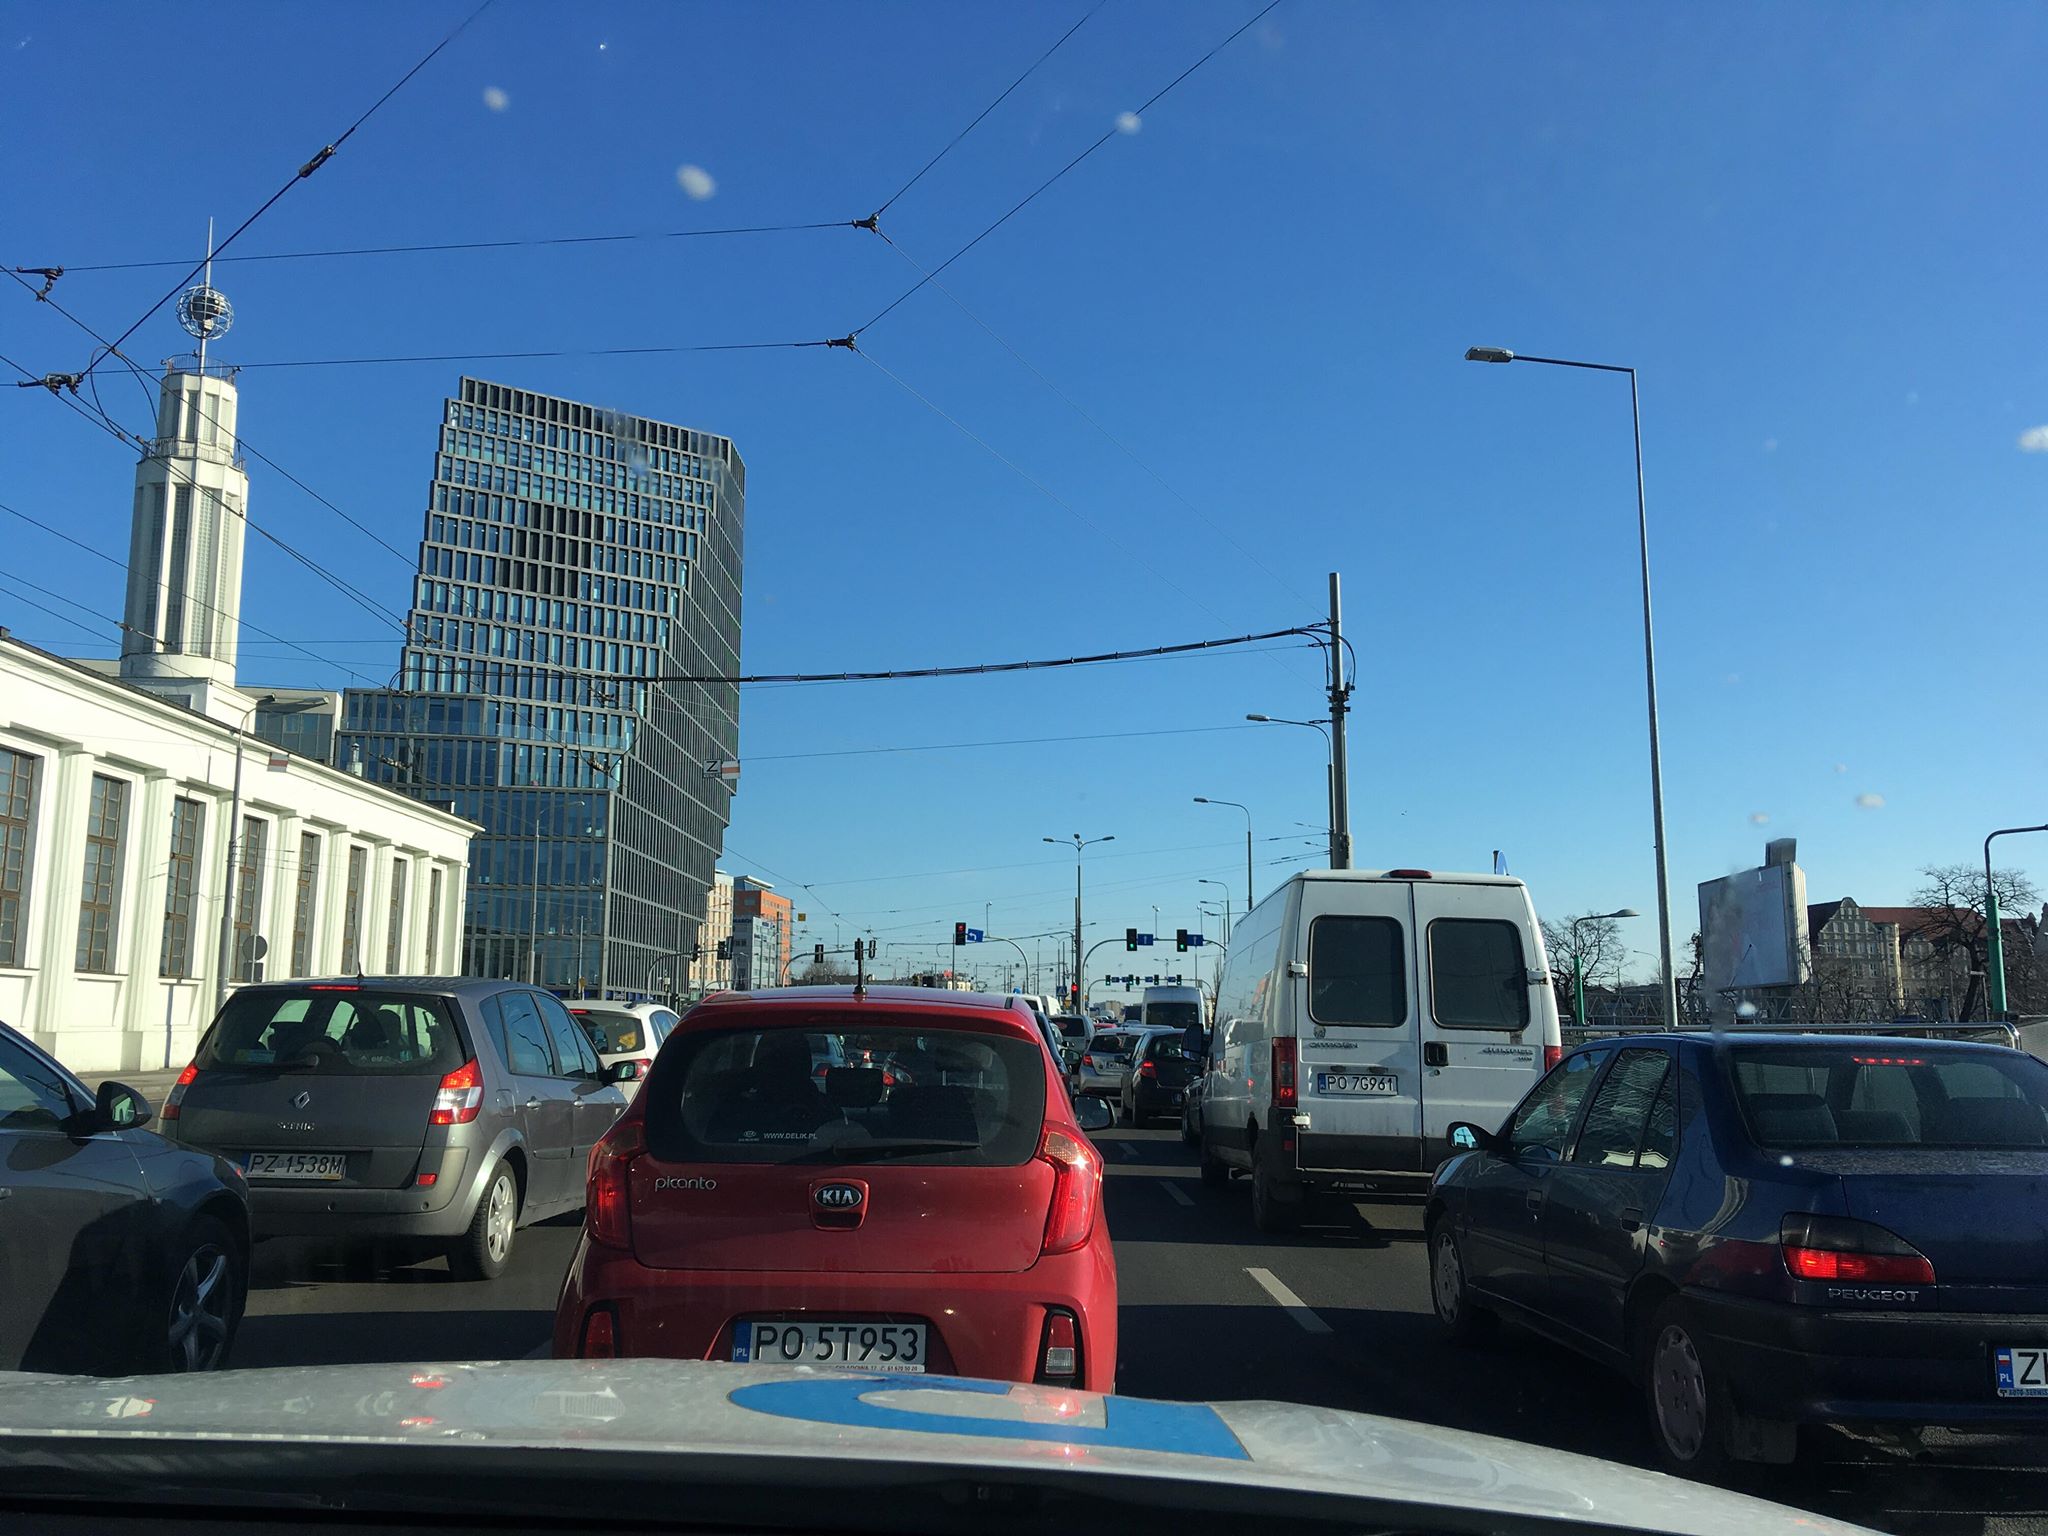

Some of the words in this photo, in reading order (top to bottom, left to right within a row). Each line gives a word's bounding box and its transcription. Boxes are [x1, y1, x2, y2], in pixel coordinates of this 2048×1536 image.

[1327, 1076, 1347, 1090] PO
[1352, 1076, 1393, 1091] 7G961
[250, 1155, 279, 1173] PZ
[286, 1155, 343, 1174] 1538M
[655, 1176, 717, 1192] picanto
[822, 1189, 854, 1204] KIA
[1828, 1287, 1919, 1302] PEUGEOT
[755, 1326, 804, 1361] PO
[814, 1326, 919, 1362] 5T953
[735, 1347, 748, 1358] PL
[1999, 1373, 2012, 1383] PL
